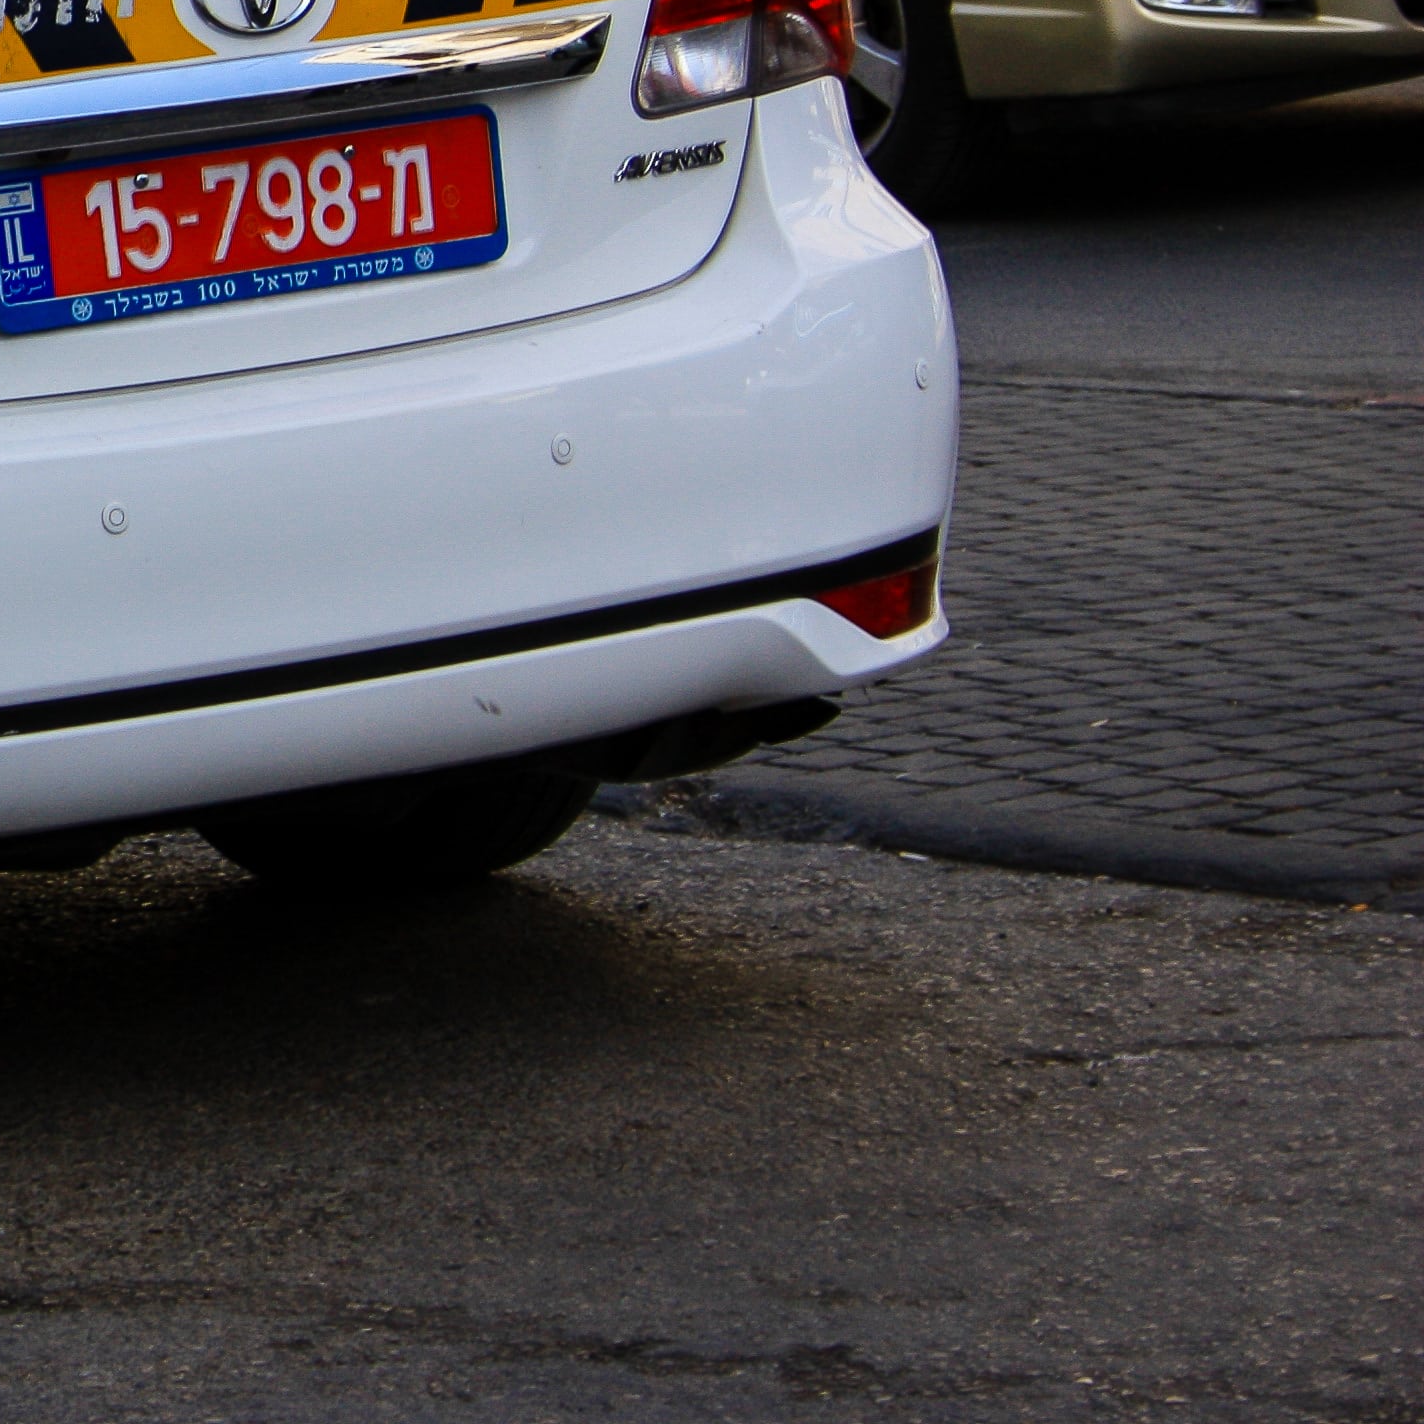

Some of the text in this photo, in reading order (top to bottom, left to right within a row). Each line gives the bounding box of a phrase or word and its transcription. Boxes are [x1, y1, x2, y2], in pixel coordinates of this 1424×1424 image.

[3, 217, 35, 265] IL
[1, 264, 44, 282] ישראל
[105, 255, 404, 317] משטרת ישראל 100 בשבילך
